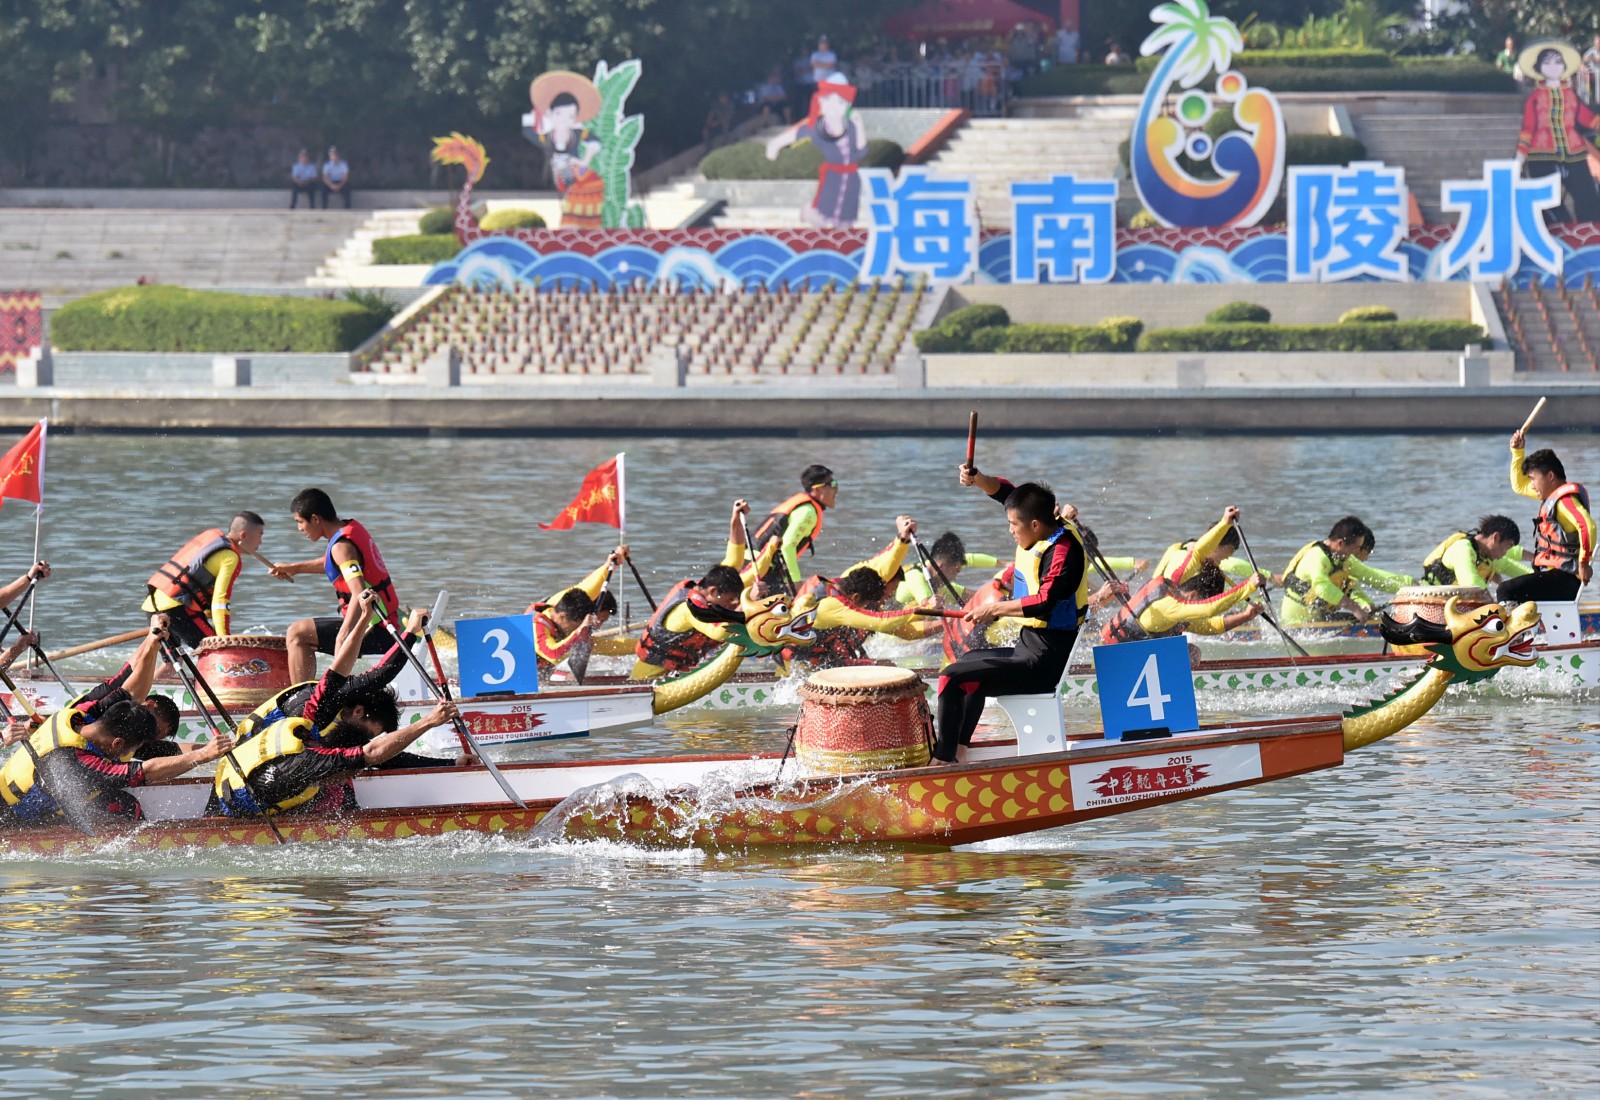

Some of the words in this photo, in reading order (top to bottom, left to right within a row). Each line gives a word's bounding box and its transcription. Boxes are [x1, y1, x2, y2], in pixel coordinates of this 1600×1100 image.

[862, 169, 1118, 283] 海南
[1289, 162, 1562, 282] 陵水
[482, 628, 516, 685] 3
[1127, 653, 1171, 721] 4
[511, 705, 532, 713] 2015
[506, 731, 552, 740] TOURNAMENT
[1167, 755, 1193, 765] 2015
[1086, 798, 1113, 807] CHINA
[1115, 791, 1160, 803] LONGZHOU
